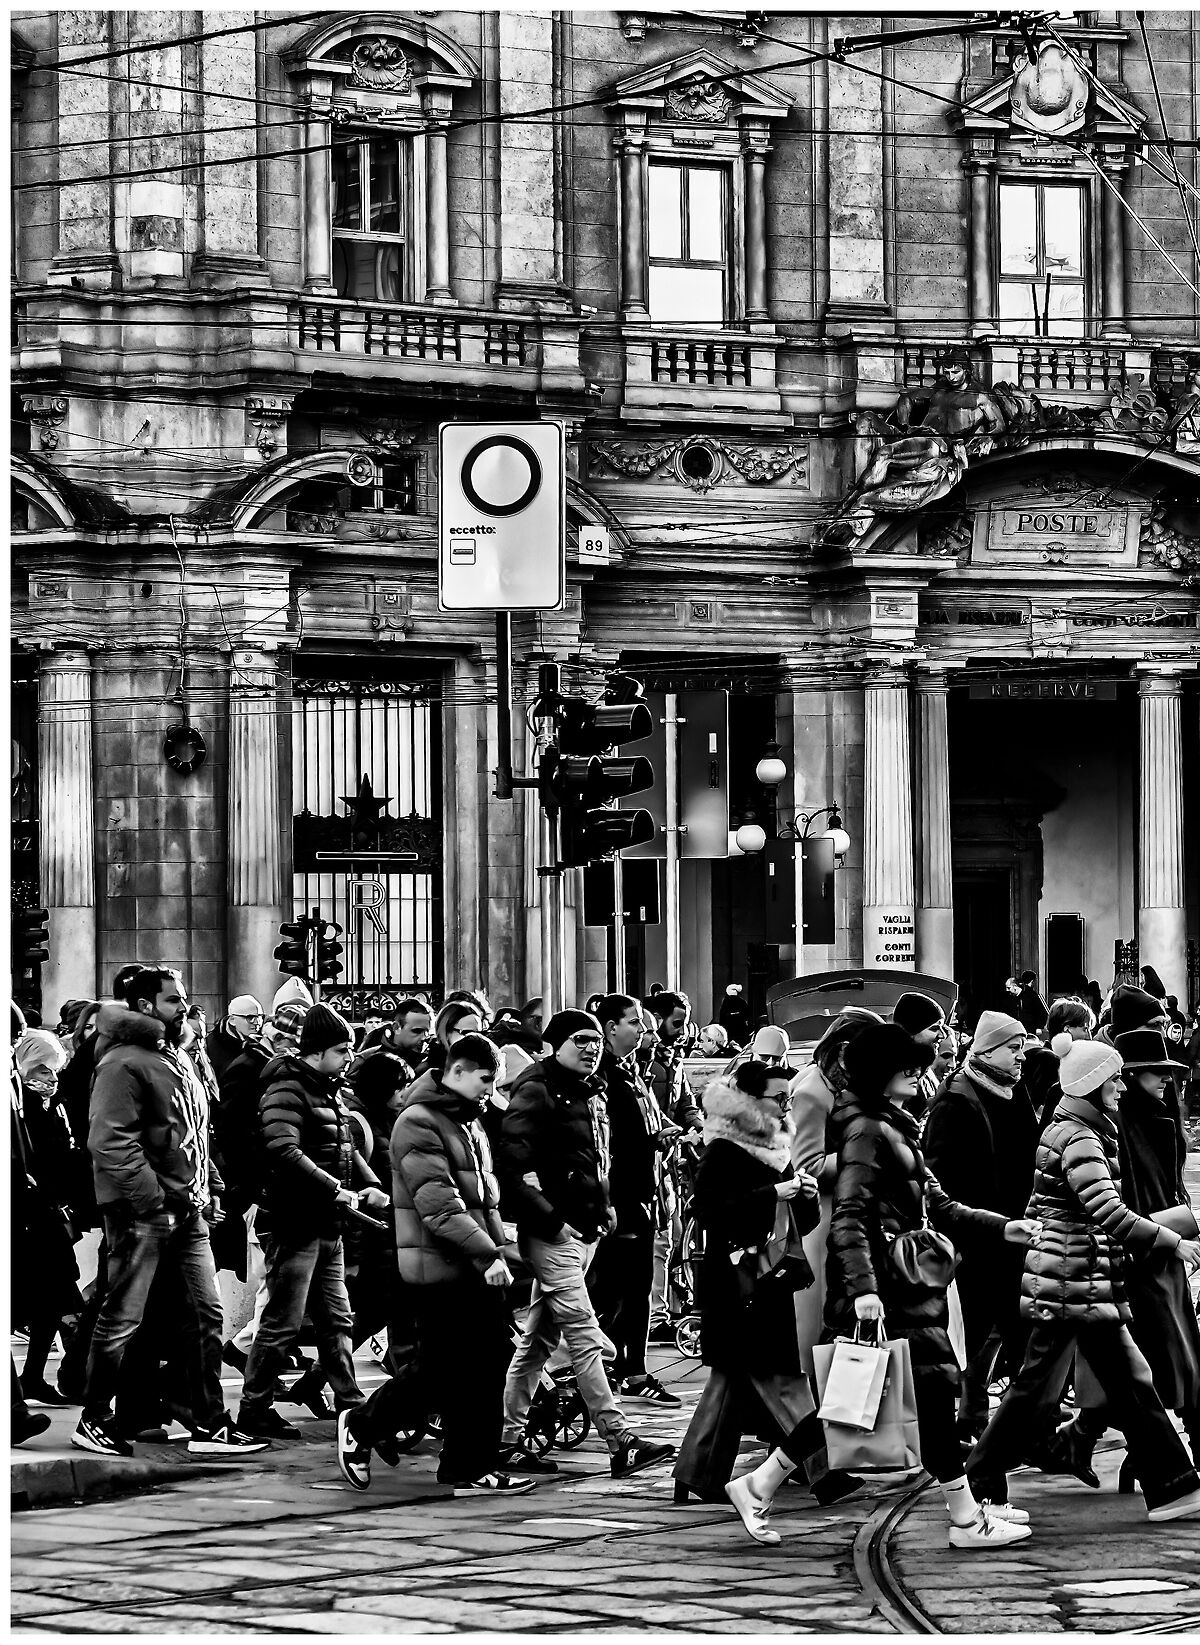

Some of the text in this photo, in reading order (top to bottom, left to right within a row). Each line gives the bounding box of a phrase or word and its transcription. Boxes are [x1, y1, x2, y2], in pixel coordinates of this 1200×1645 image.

[1018, 514, 1098, 533] POSTE
[450, 525, 497, 534] eccetto:
[585, 540, 603, 551] 89
[991, 683, 1095, 698] RESERVE
[349, 880, 386, 934] R
[882, 915, 911, 924] VAGLIA
[884, 943, 911, 951] CONTI
